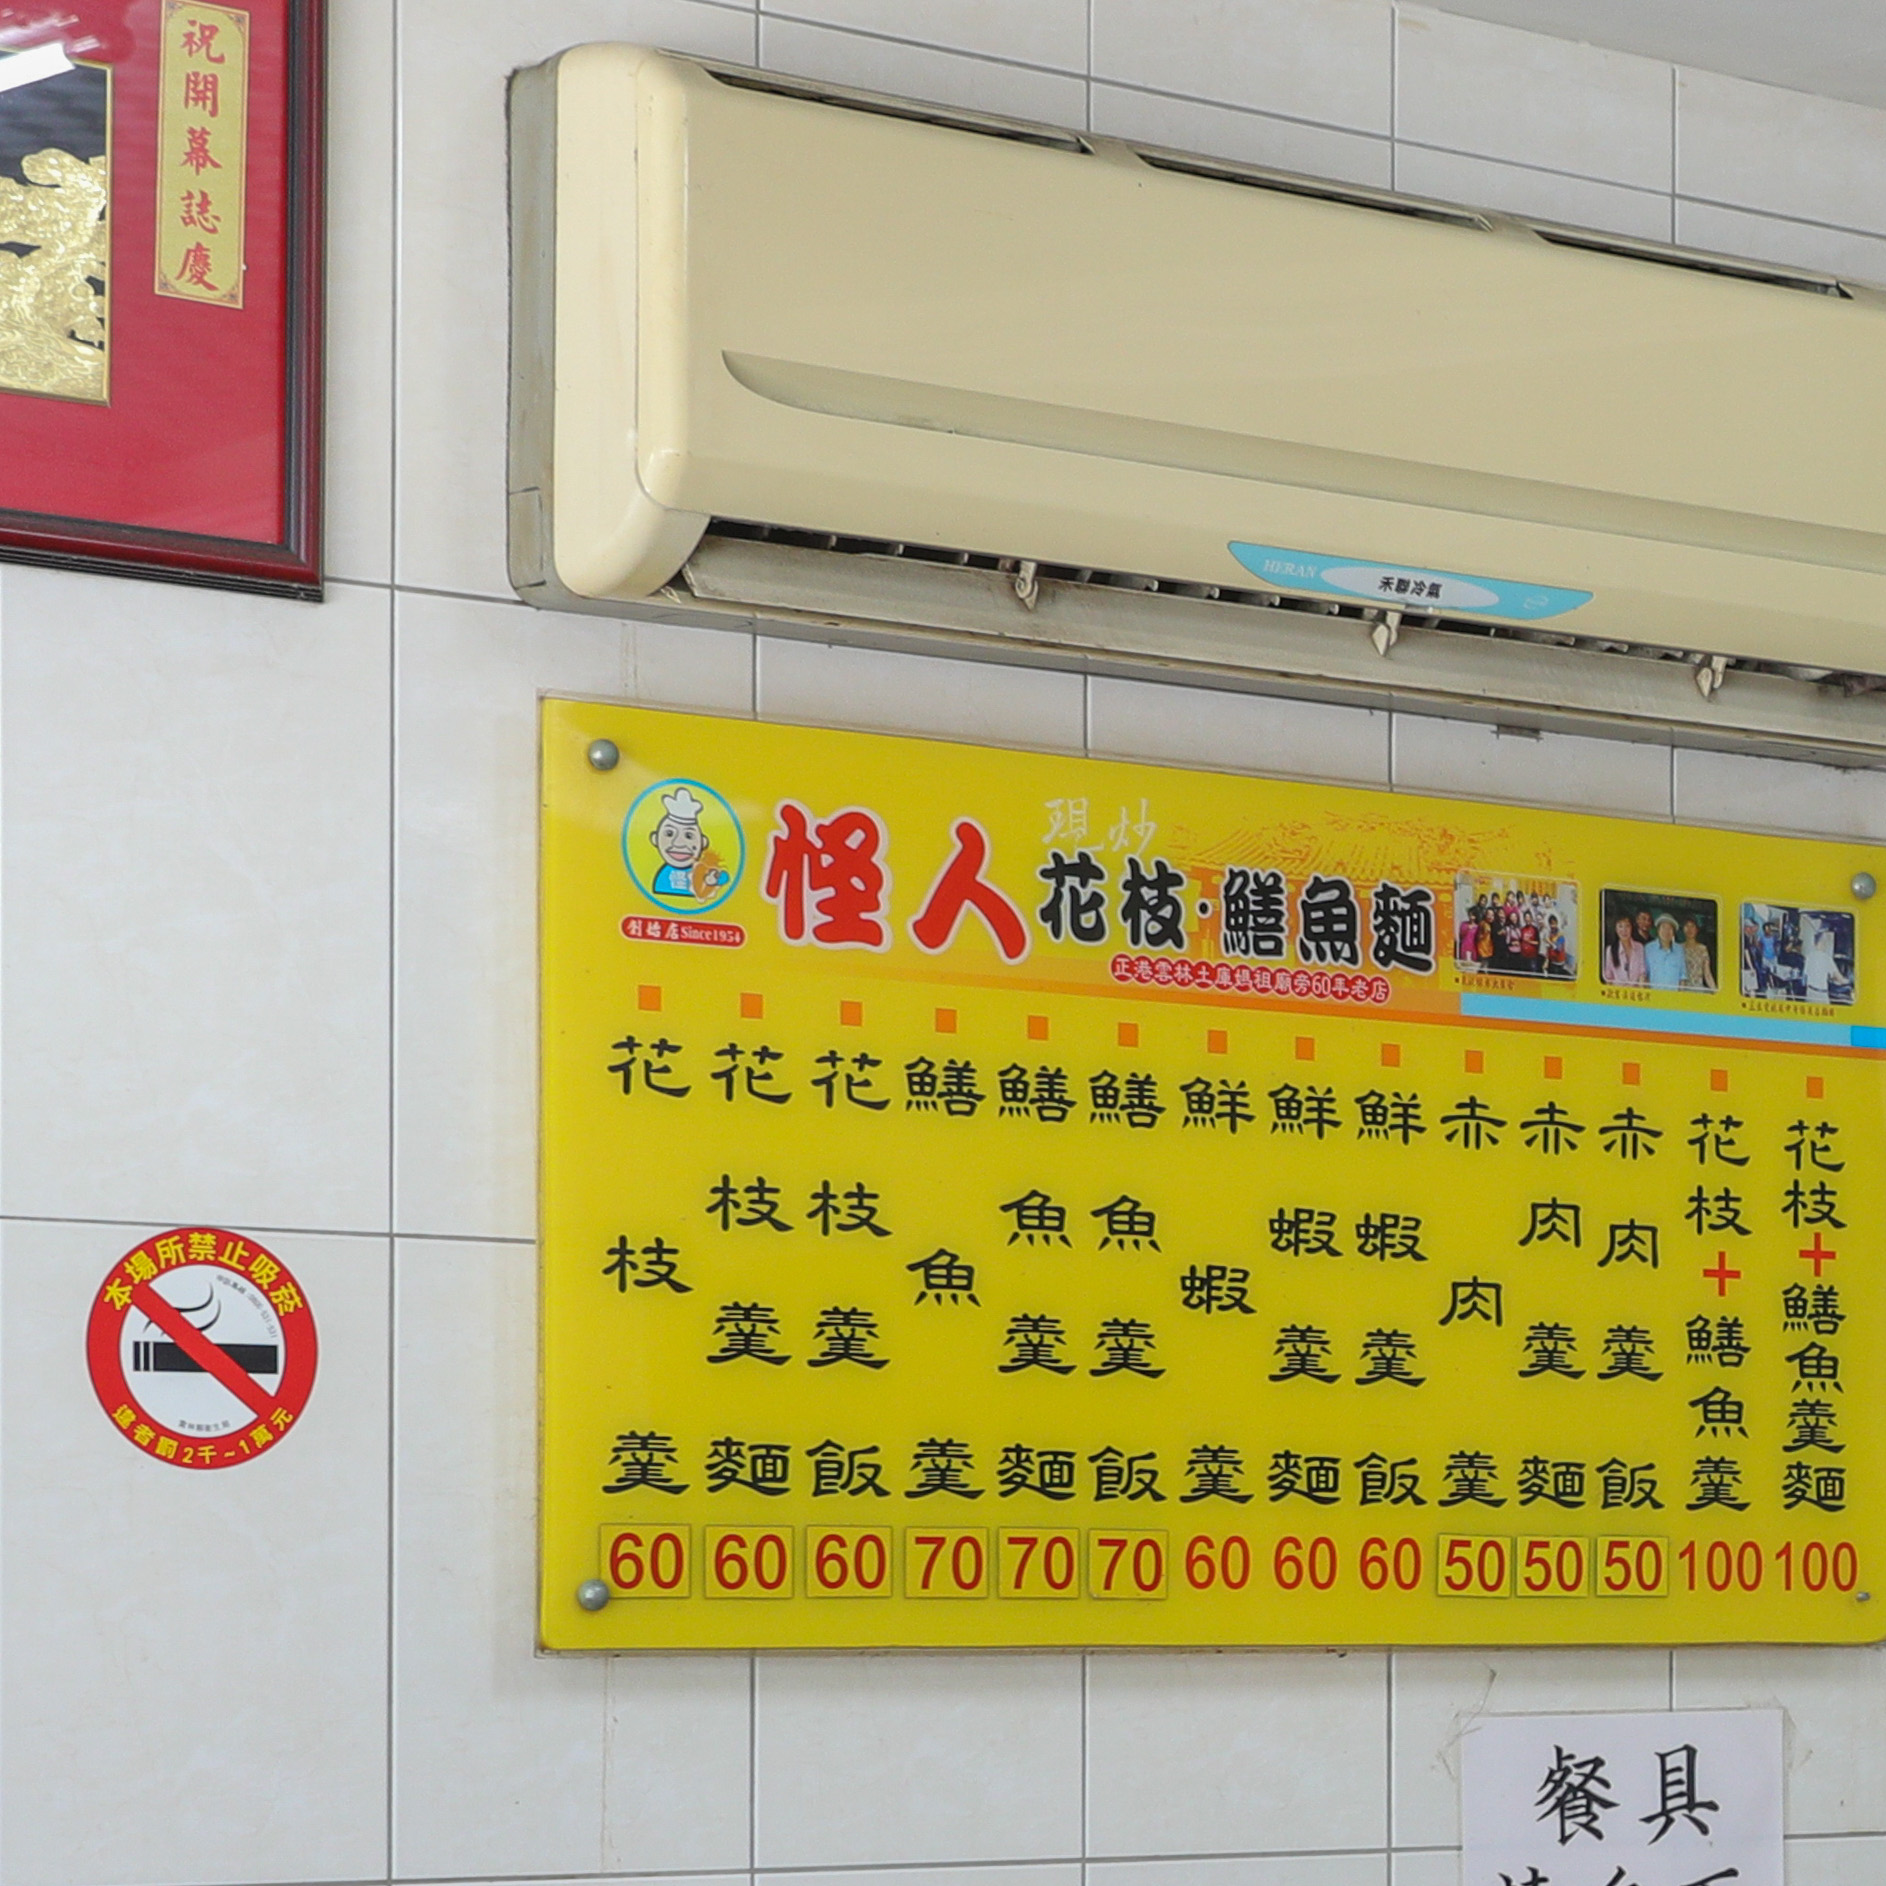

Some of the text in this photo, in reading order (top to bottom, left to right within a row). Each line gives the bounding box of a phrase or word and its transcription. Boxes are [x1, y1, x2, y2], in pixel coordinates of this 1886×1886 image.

[173, 18, 227, 293] 祝開幕誌慶
[764, 801, 1028, 961] 怪人
[104, 1231, 304, 1316] 本場所禁止吸菸
[609, 1532, 1858, 1593] 60 60 60 70 70 70 60 60 60 50 50 50 100 100
[1533, 1743, 1720, 1846] 餐具
